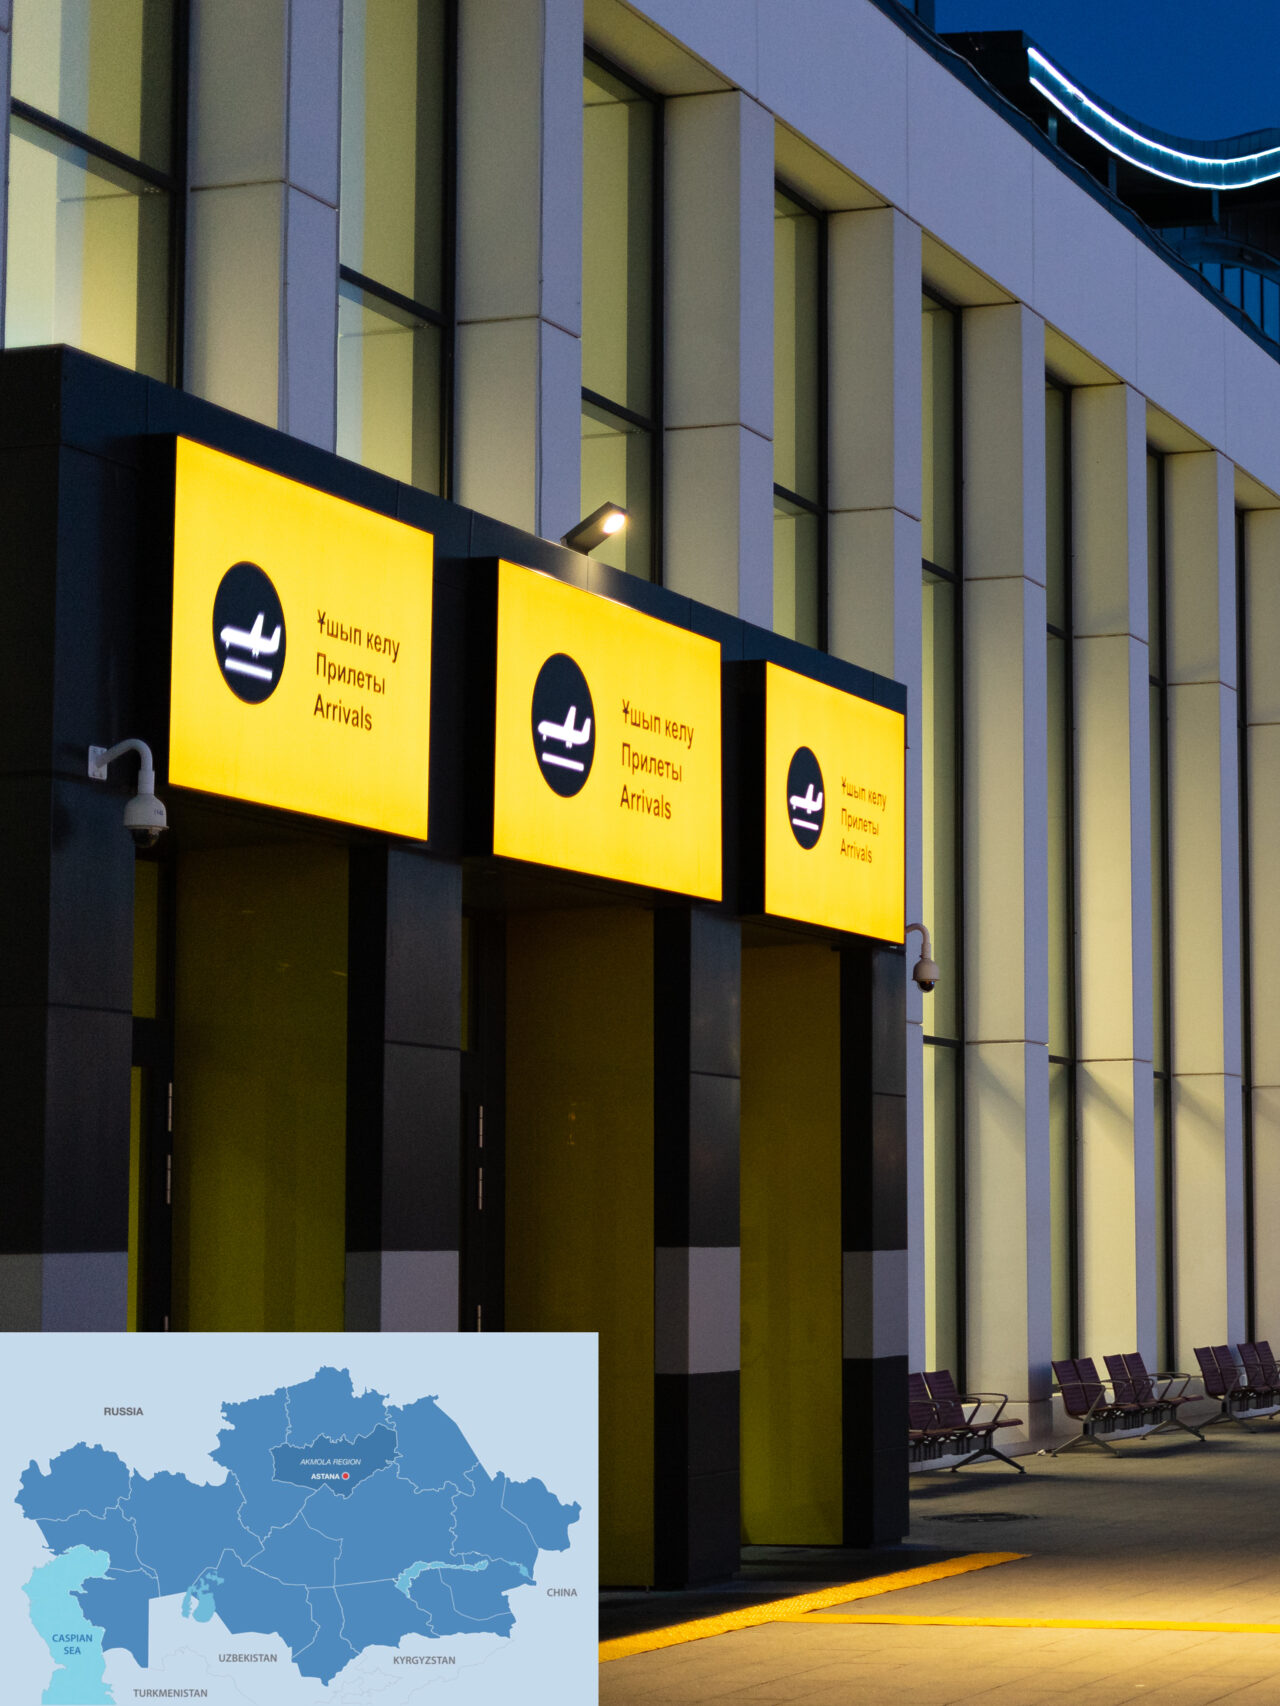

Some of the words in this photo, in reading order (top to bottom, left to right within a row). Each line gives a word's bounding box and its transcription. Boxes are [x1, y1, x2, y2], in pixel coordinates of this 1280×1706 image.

[317, 609, 362, 647] Ұшып
[367, 632, 400, 663] келу
[316, 652, 386, 695] Прилеты
[313, 693, 373, 731] Arrivals
[622, 699, 661, 735] Ұшып
[665, 719, 694, 750] келу
[622, 742, 682, 782] Прилеты
[620, 784, 672, 820] Arrivals
[868, 789, 887, 812] келу
[841, 808, 879, 836] Прилеты
[840, 838, 873, 864] Arrivals
